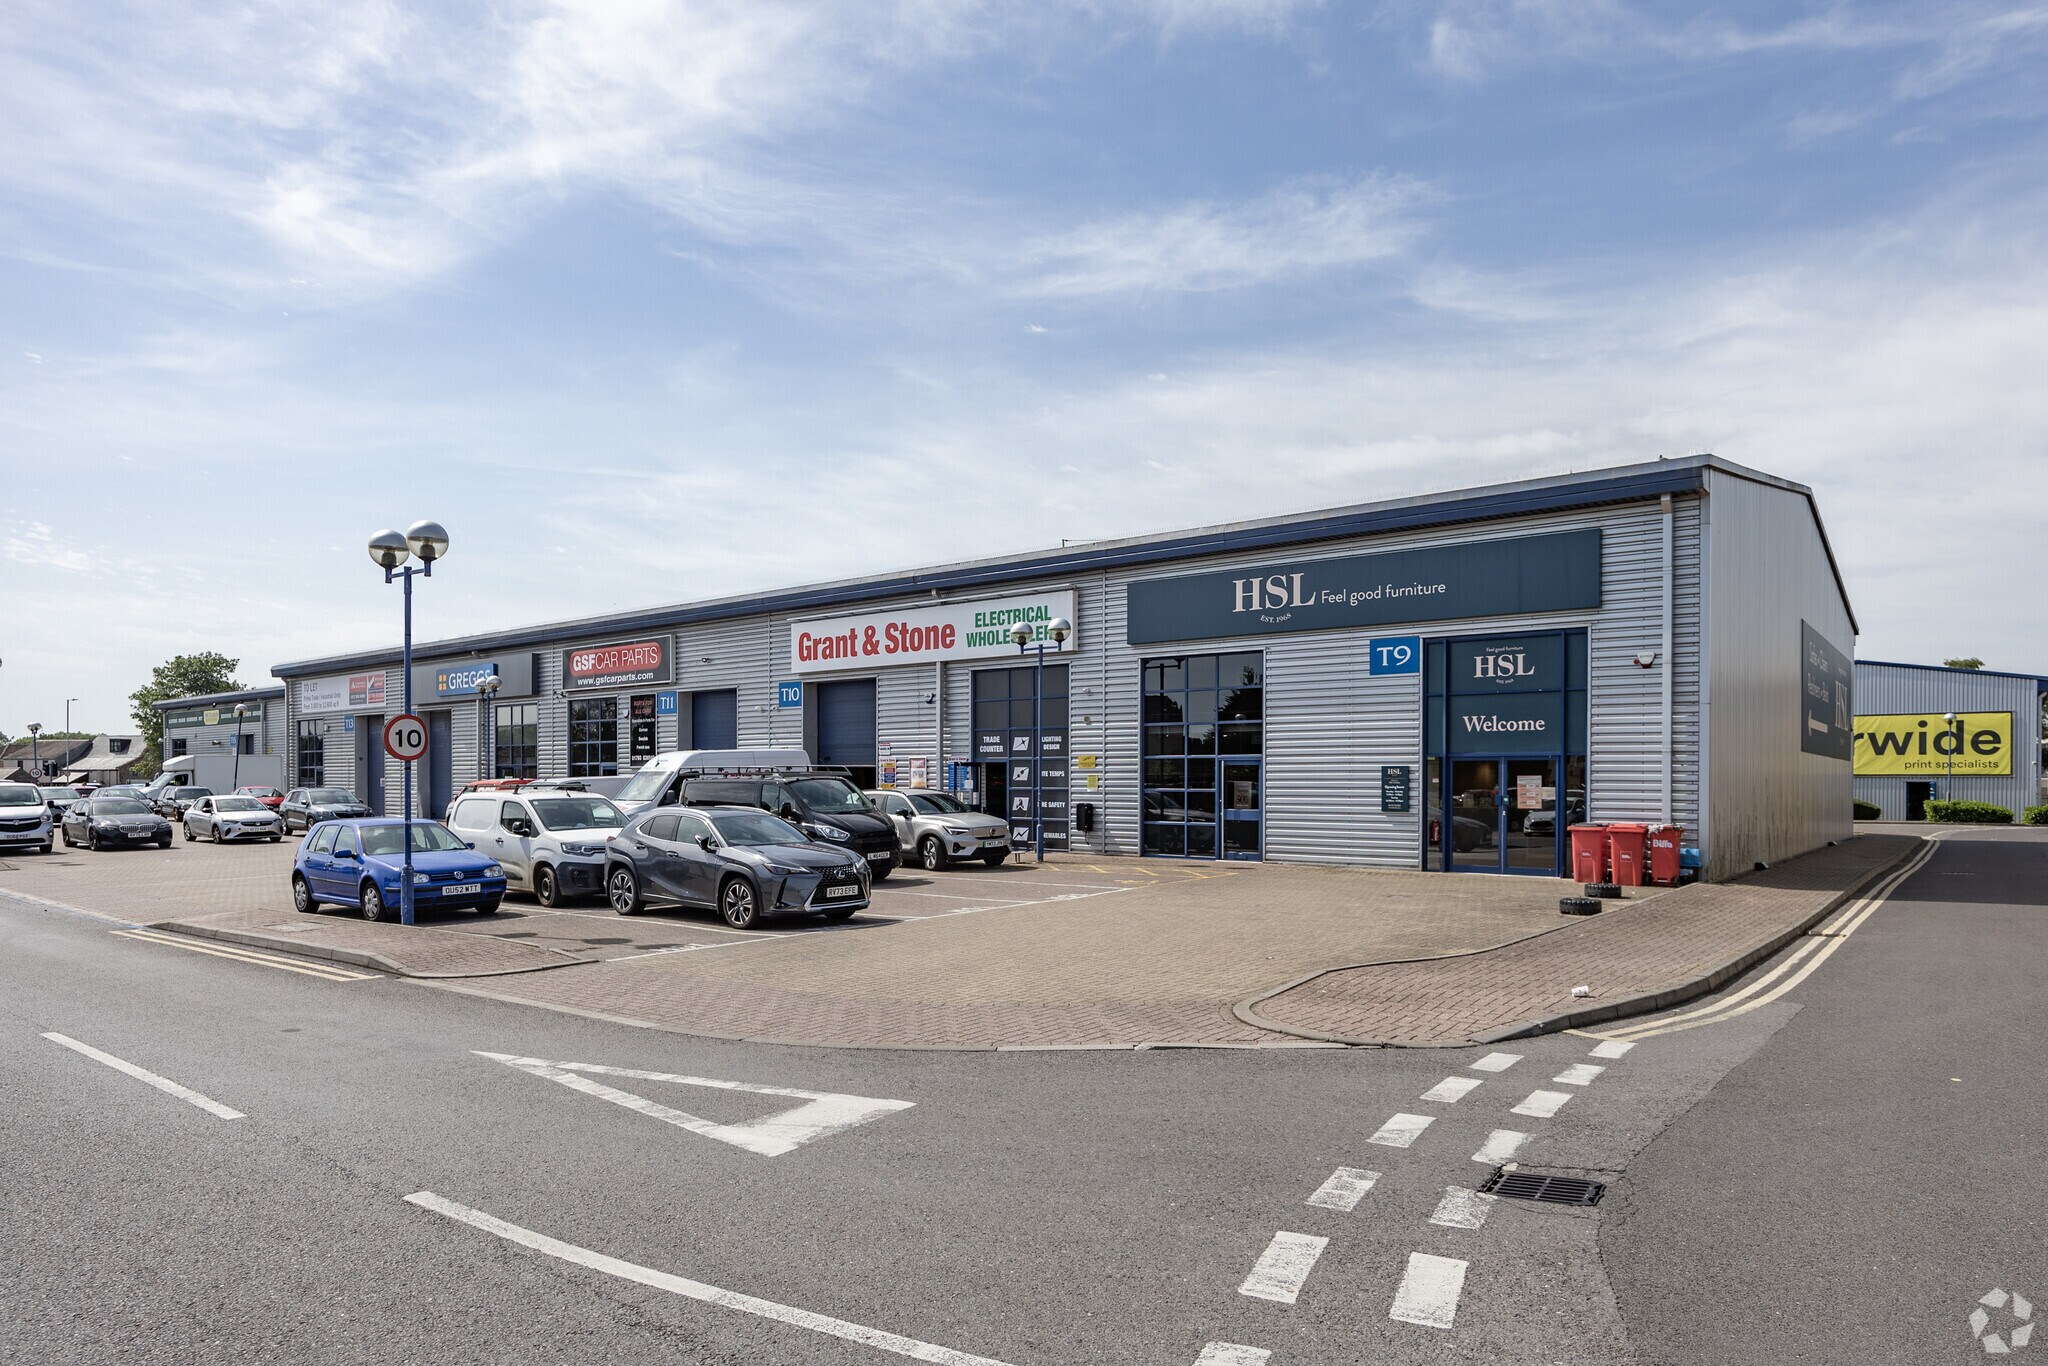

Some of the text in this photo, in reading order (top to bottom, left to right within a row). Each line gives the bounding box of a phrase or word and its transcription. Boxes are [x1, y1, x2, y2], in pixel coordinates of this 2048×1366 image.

[1232, 572, 1447, 613] HSL Feel good furniture
[974, 605, 1052, 628] ELECTRICAL
[798, 622, 956, 662] Grant & Stone
[966, 624, 1053, 648] WHOLEER
[621, 646, 658, 666] PARTS
[1376, 645, 1411, 666] T9
[1473, 653, 1535, 678] HSL
[577, 672, 654, 686] www.gsfcarparts.com
[310, 682, 318, 692] LET
[780, 687, 800, 702] T10
[660, 696, 674, 710] T11
[1462, 715, 1546, 732] Welcome
[395, 729, 421, 749] 10
[983, 735, 1000, 744] TRADE
[1041, 735, 1062, 743] LIGHTING
[980, 745, 1004, 753] COUNTER
[1904, 760, 1999, 770] print specialists
[1652, 838, 1673, 849] Biffa
[844, 886, 857, 895] EFE
